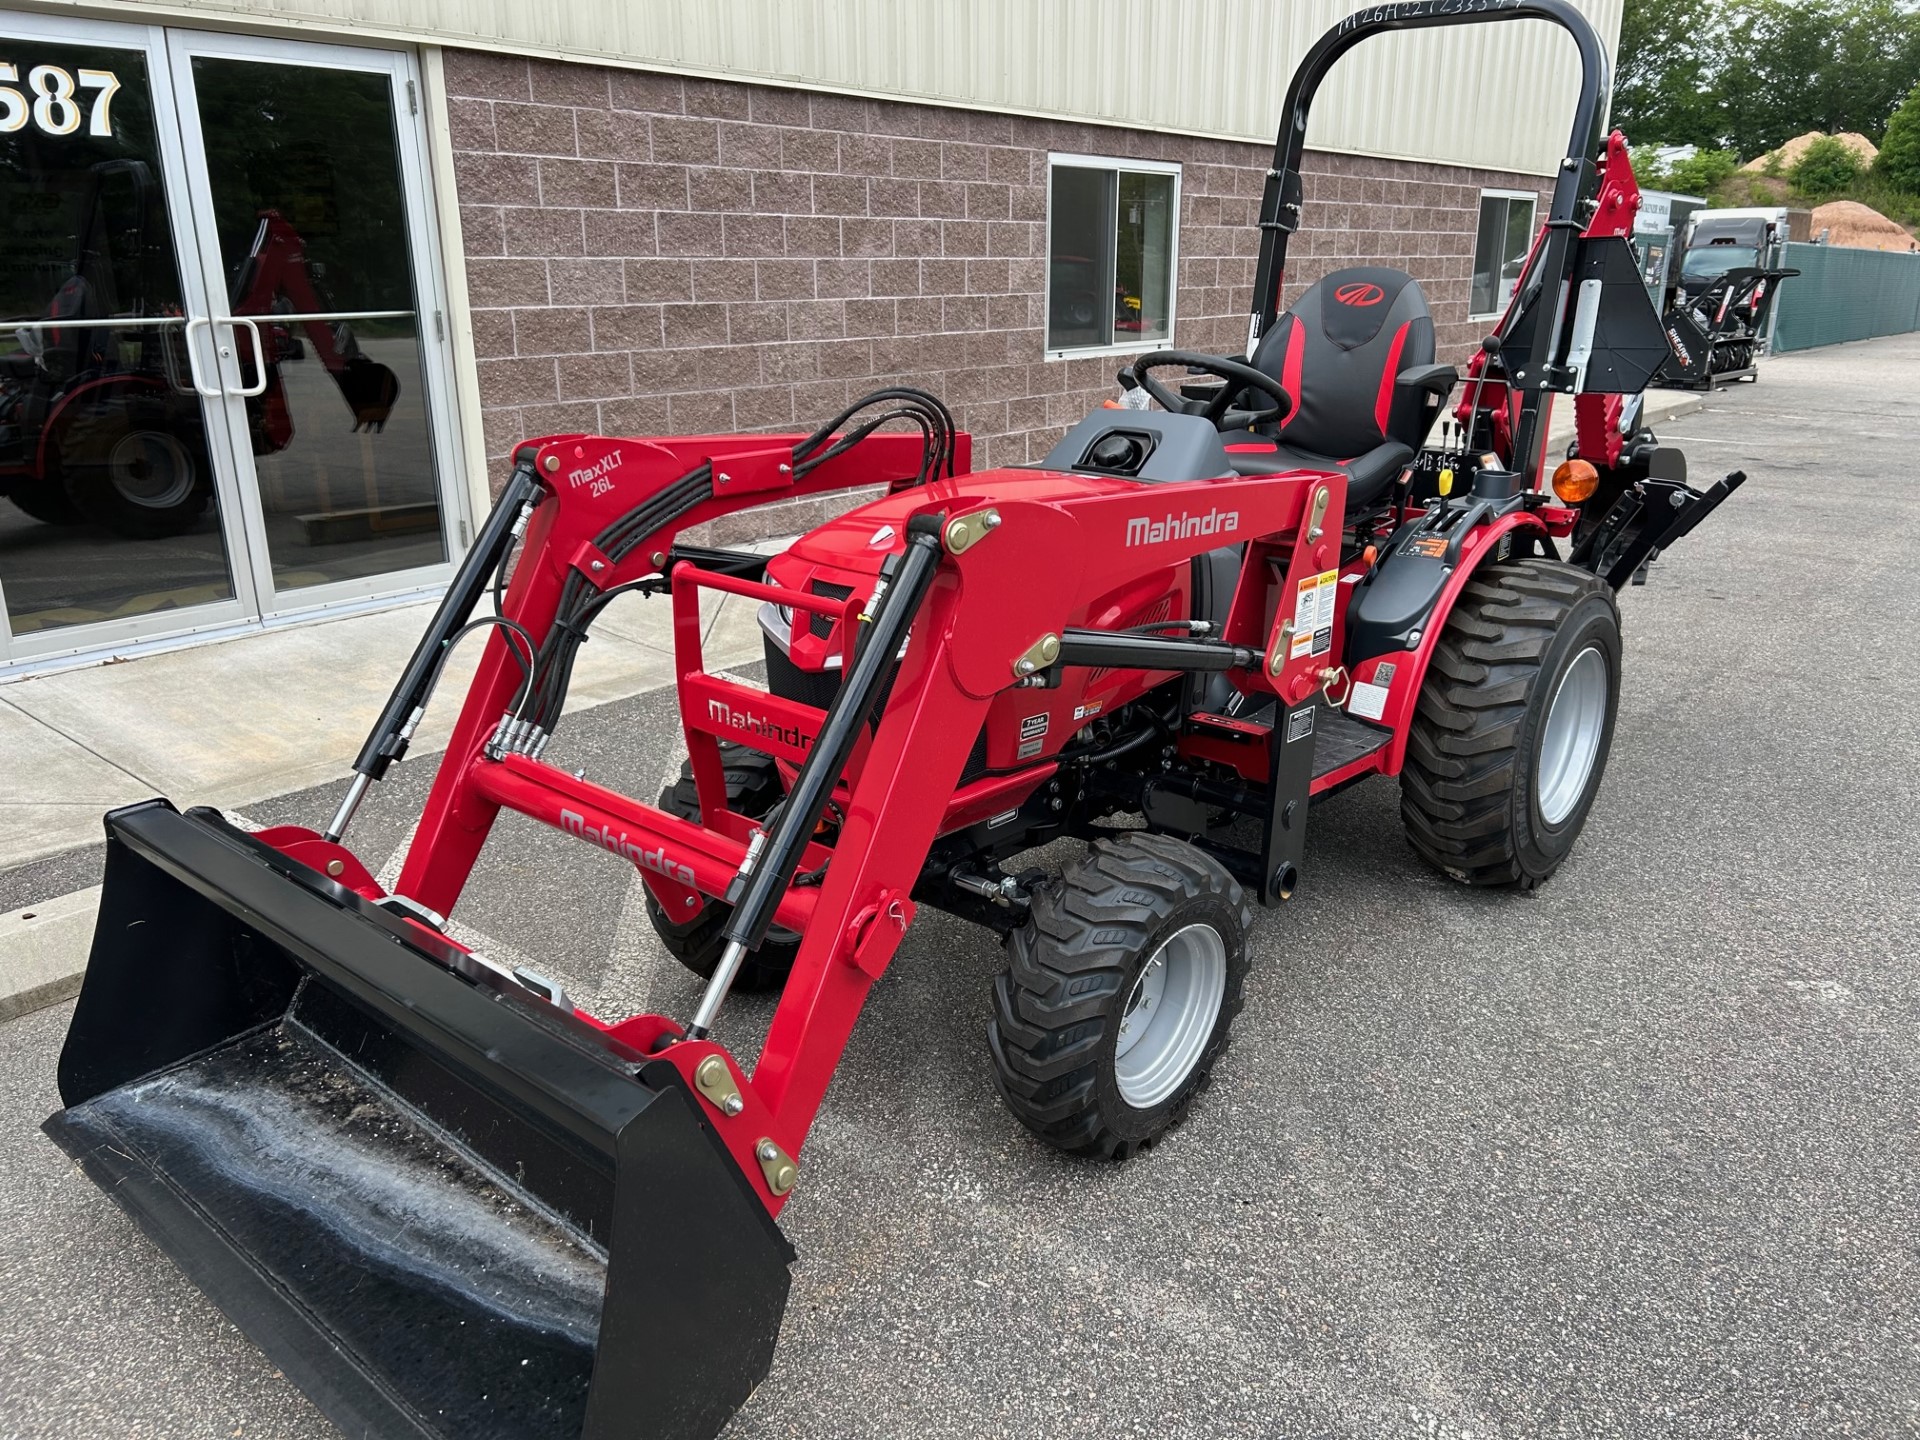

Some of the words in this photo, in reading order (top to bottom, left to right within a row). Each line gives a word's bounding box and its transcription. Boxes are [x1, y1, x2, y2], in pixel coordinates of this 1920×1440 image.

[0, 61, 121, 137] 587
[589, 475, 615, 498] 26L
[1125, 506, 1239, 548] Mahindra
[708, 698, 818, 750] Mahindr
[1026, 718, 1031, 727] 7
[1031, 716, 1045, 726] YEAR
[560, 807, 697, 888] Mahindra
